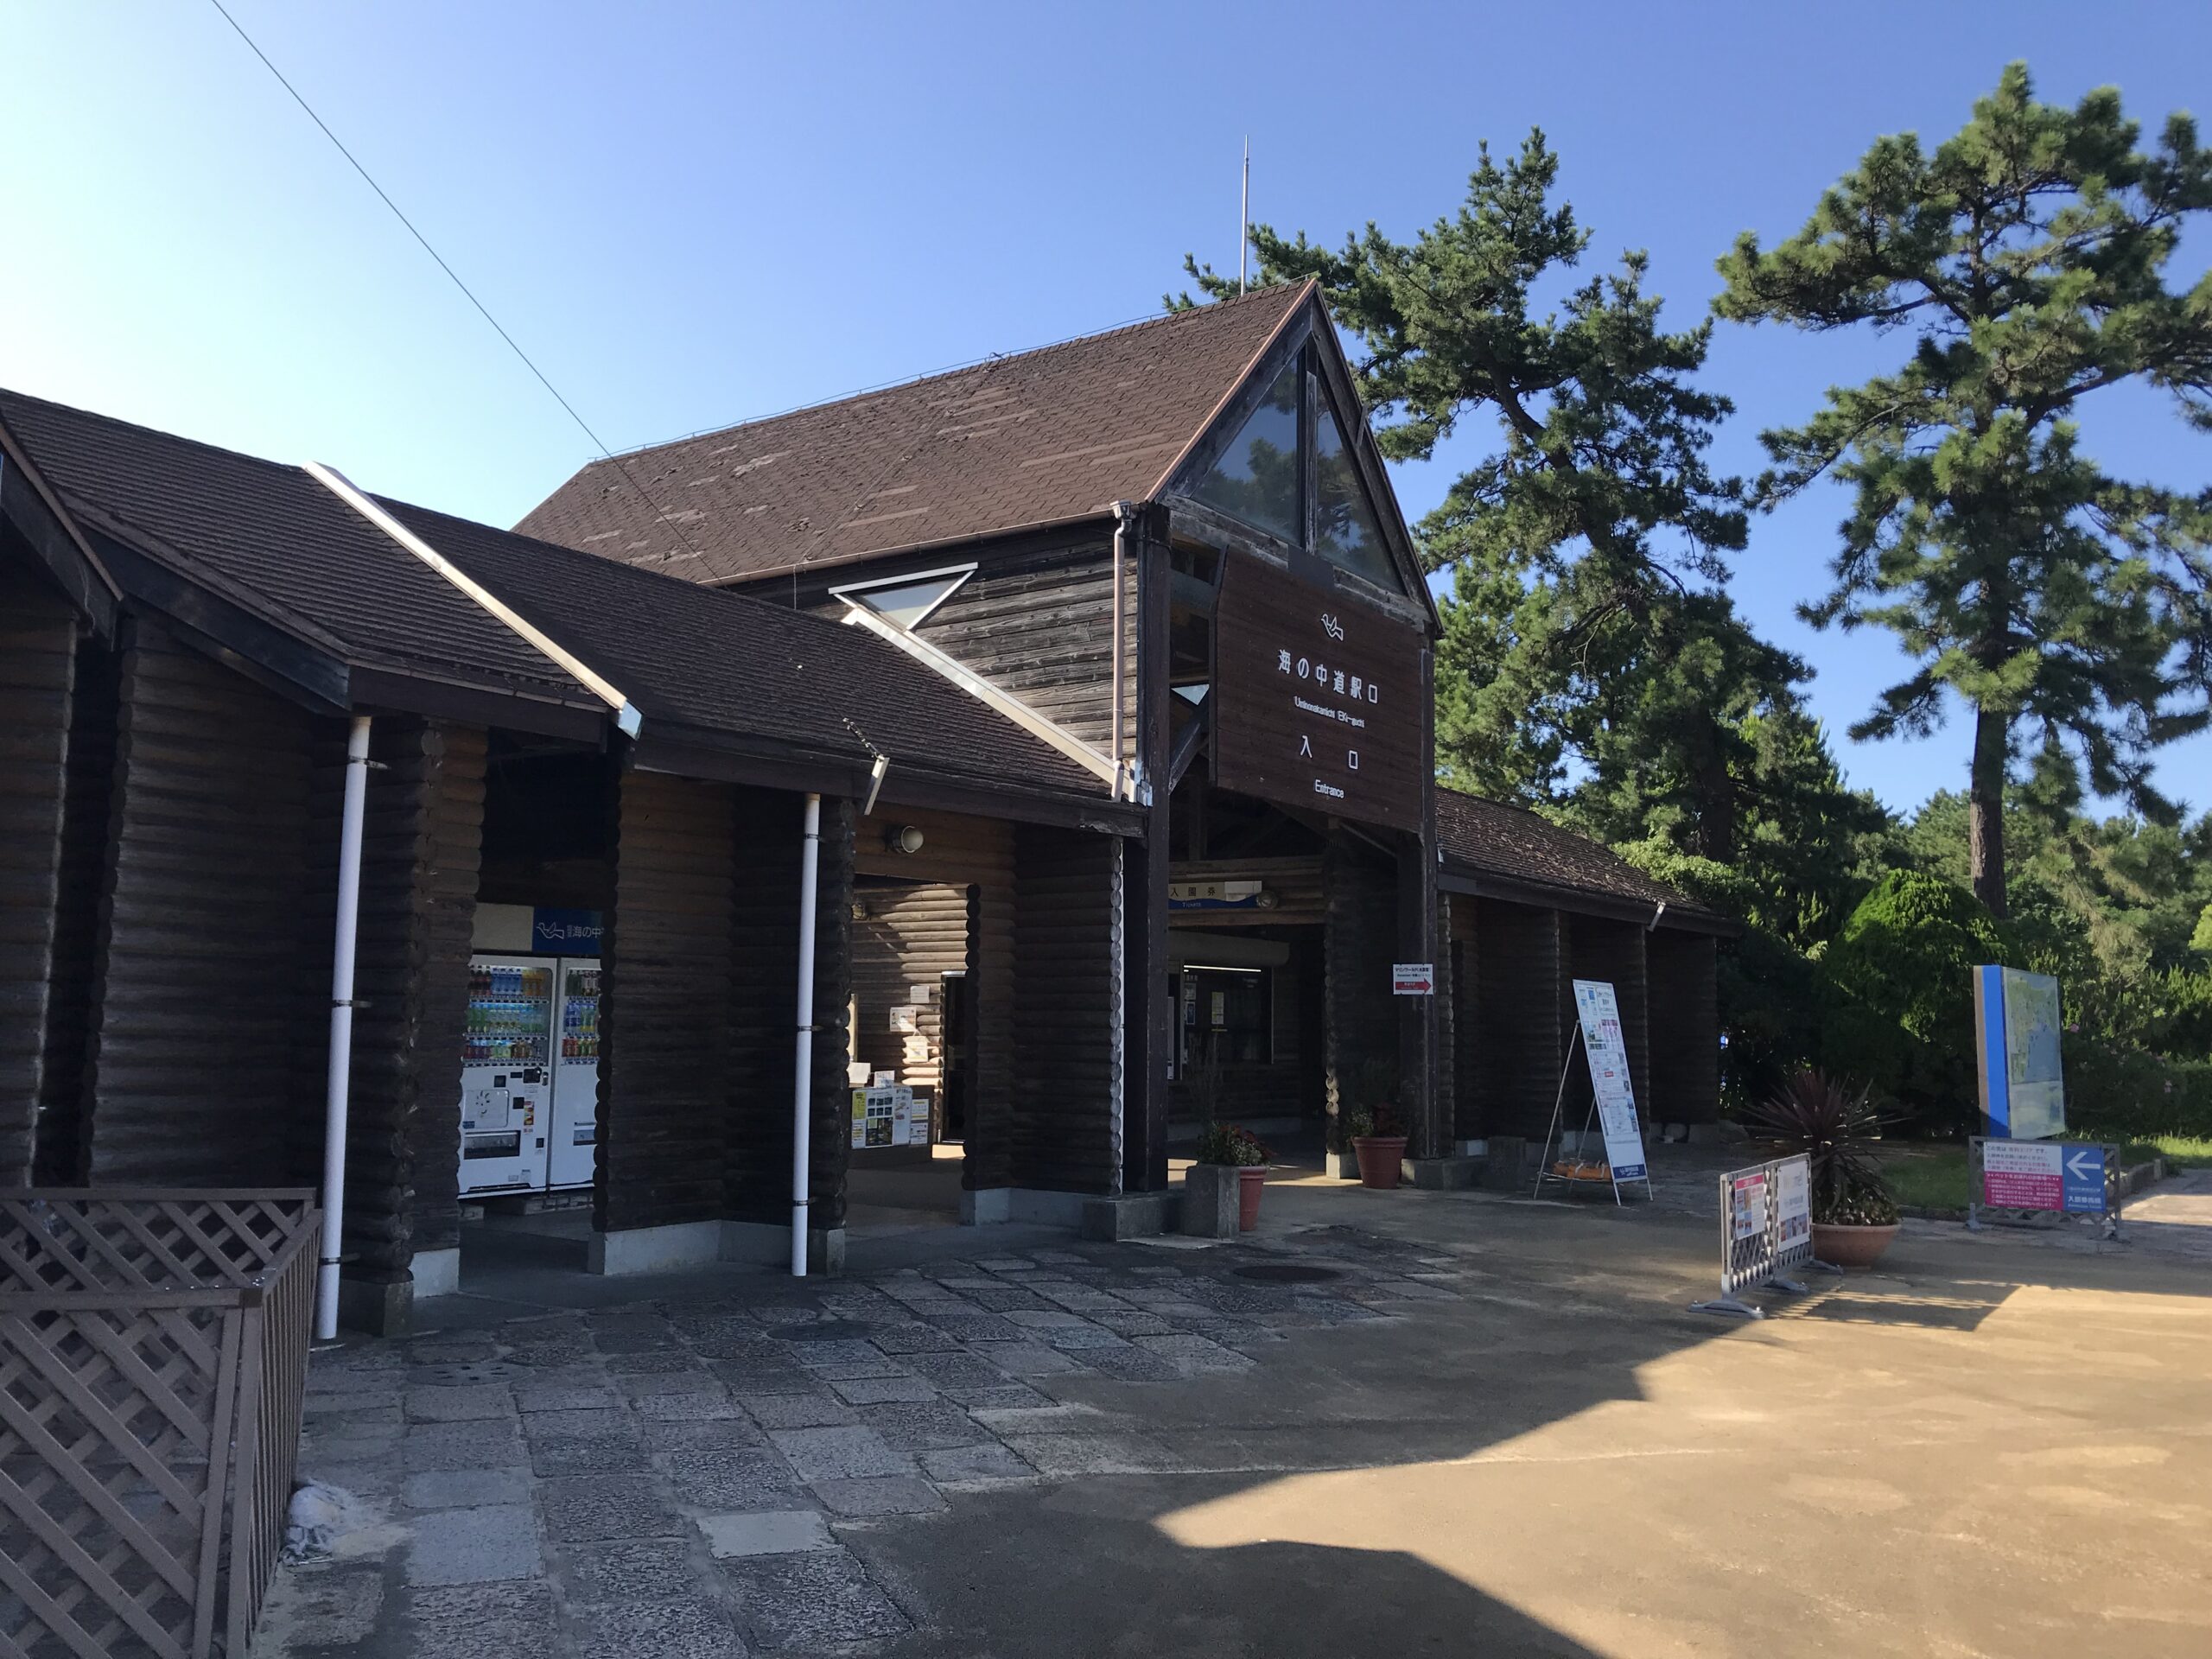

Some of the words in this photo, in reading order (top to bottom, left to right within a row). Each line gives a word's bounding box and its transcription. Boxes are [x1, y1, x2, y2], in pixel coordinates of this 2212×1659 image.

[1278, 649, 1378, 704] 海の中道駅口
[1300, 735, 1358, 769] 入口
[1314, 779, 1344, 798] Entrance
[573, 925, 604, 938] 海の中
